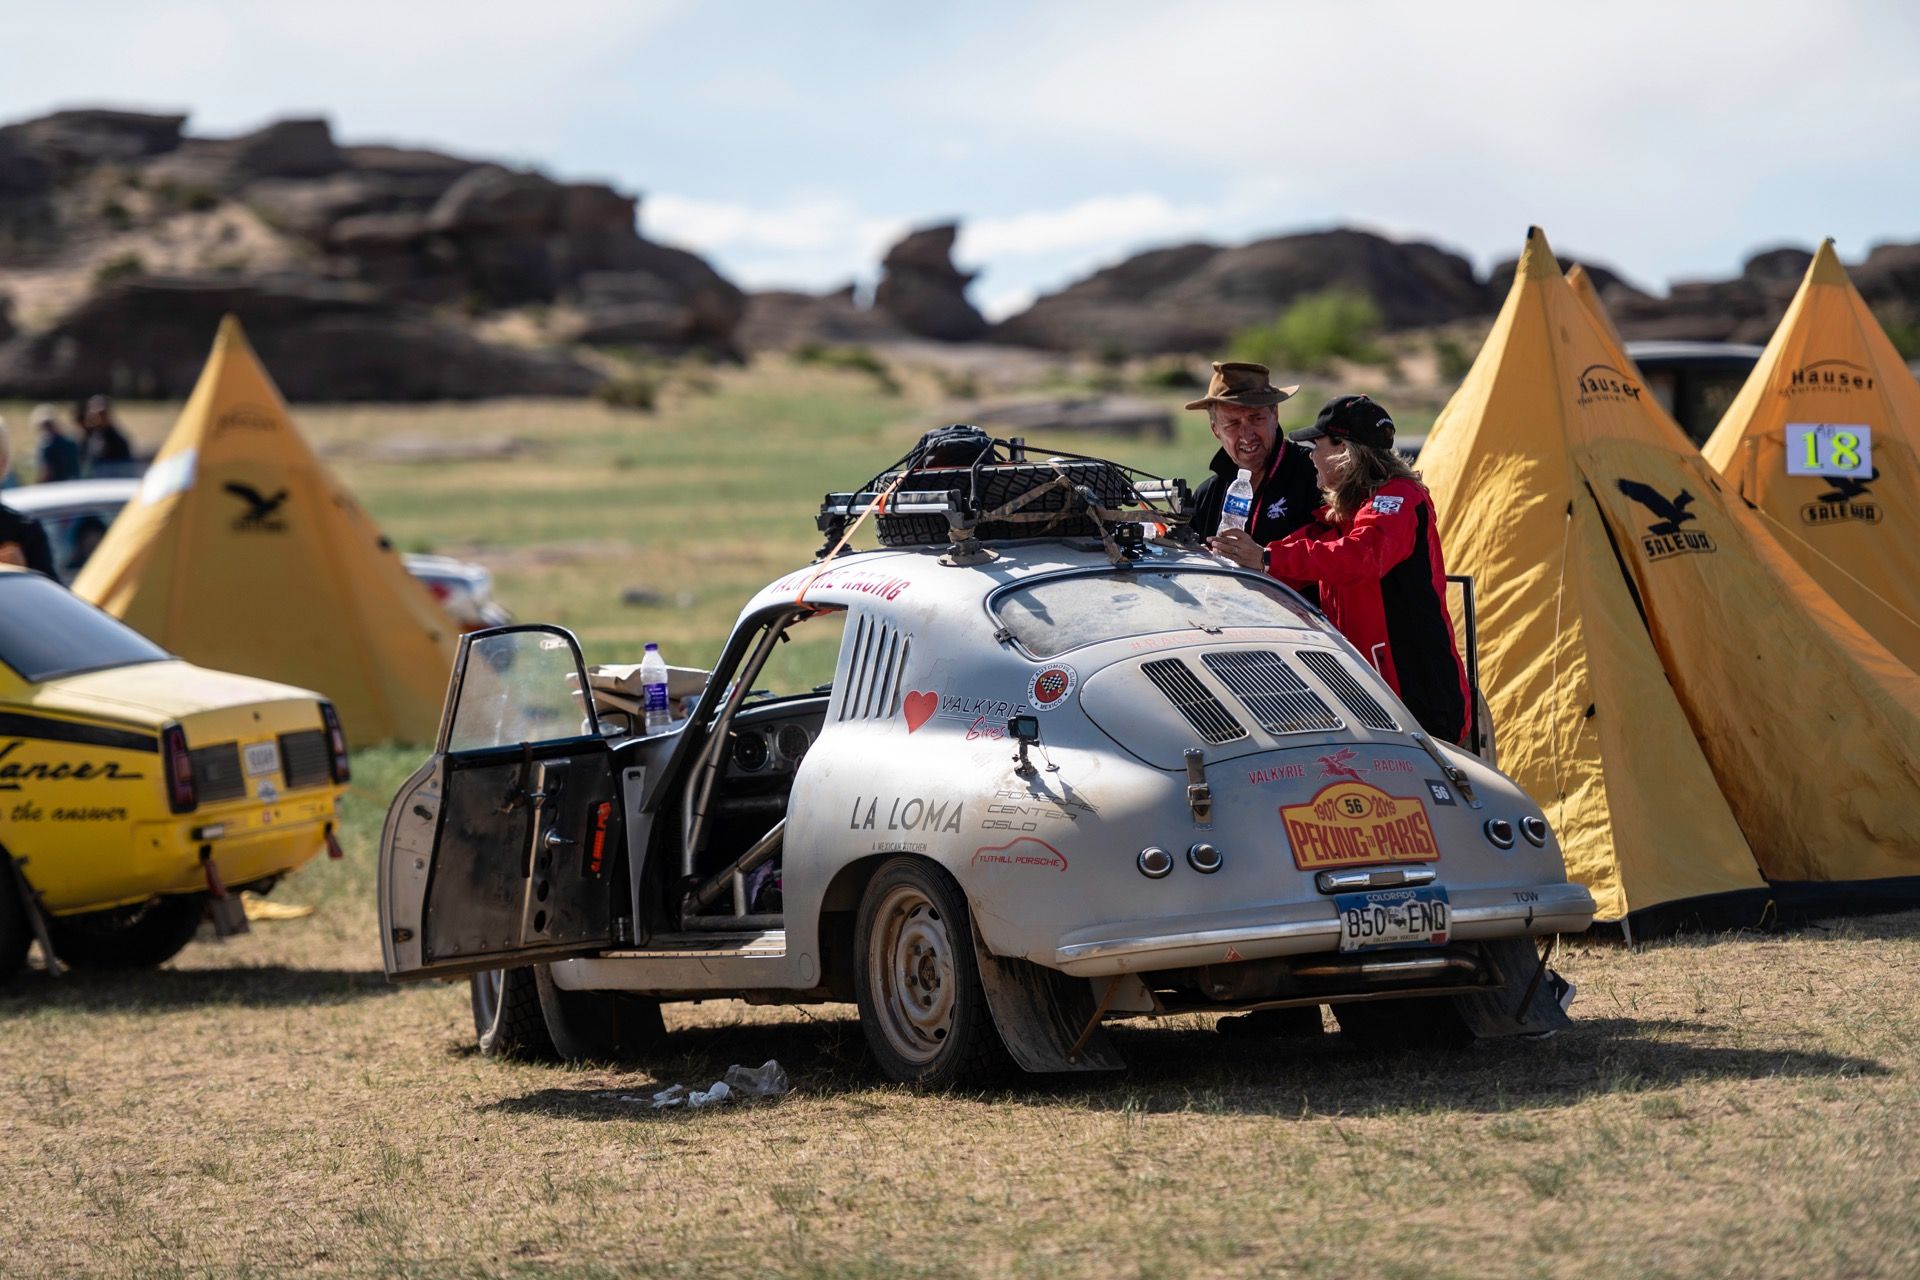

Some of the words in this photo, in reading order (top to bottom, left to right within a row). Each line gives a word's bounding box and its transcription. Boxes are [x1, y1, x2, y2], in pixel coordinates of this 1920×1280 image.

[1802, 431, 1862, 471] 18
[1807, 501, 1876, 522] SALEWA
[1643, 532, 1711, 557] SALEWA
[1039, 698, 1063, 710] MEXICO
[966, 715, 1006, 741] Gives
[1249, 764, 1305, 785] VALKYRIE
[1374, 758, 1414, 773] RACING
[1431, 785, 1450, 801] 56
[11, 800, 44, 821] the
[51, 806, 127, 821] answer
[850, 796, 878, 830] LA
[887, 797, 964, 834] LOMA
[988, 804, 1078, 821] CENTER
[1314, 799, 1337, 822] 1907
[1344, 799, 1363, 814] 56
[1372, 796, 1396, 819] 2019
[981, 819, 1037, 832] OSLO
[902, 841, 928, 852] KITCHEN
[1289, 819, 1371, 862] PEKING
[1372, 811, 1437, 856] PARIS
[979, 855, 1013, 865] TUTHILL
[1015, 855, 1061, 867] PORSCHE
[1365, 890, 1417, 903] COLORADO
[1512, 891, 1539, 903] TOW
[1347, 907, 1386, 938] 850
[1407, 902, 1446, 933] ENQ
